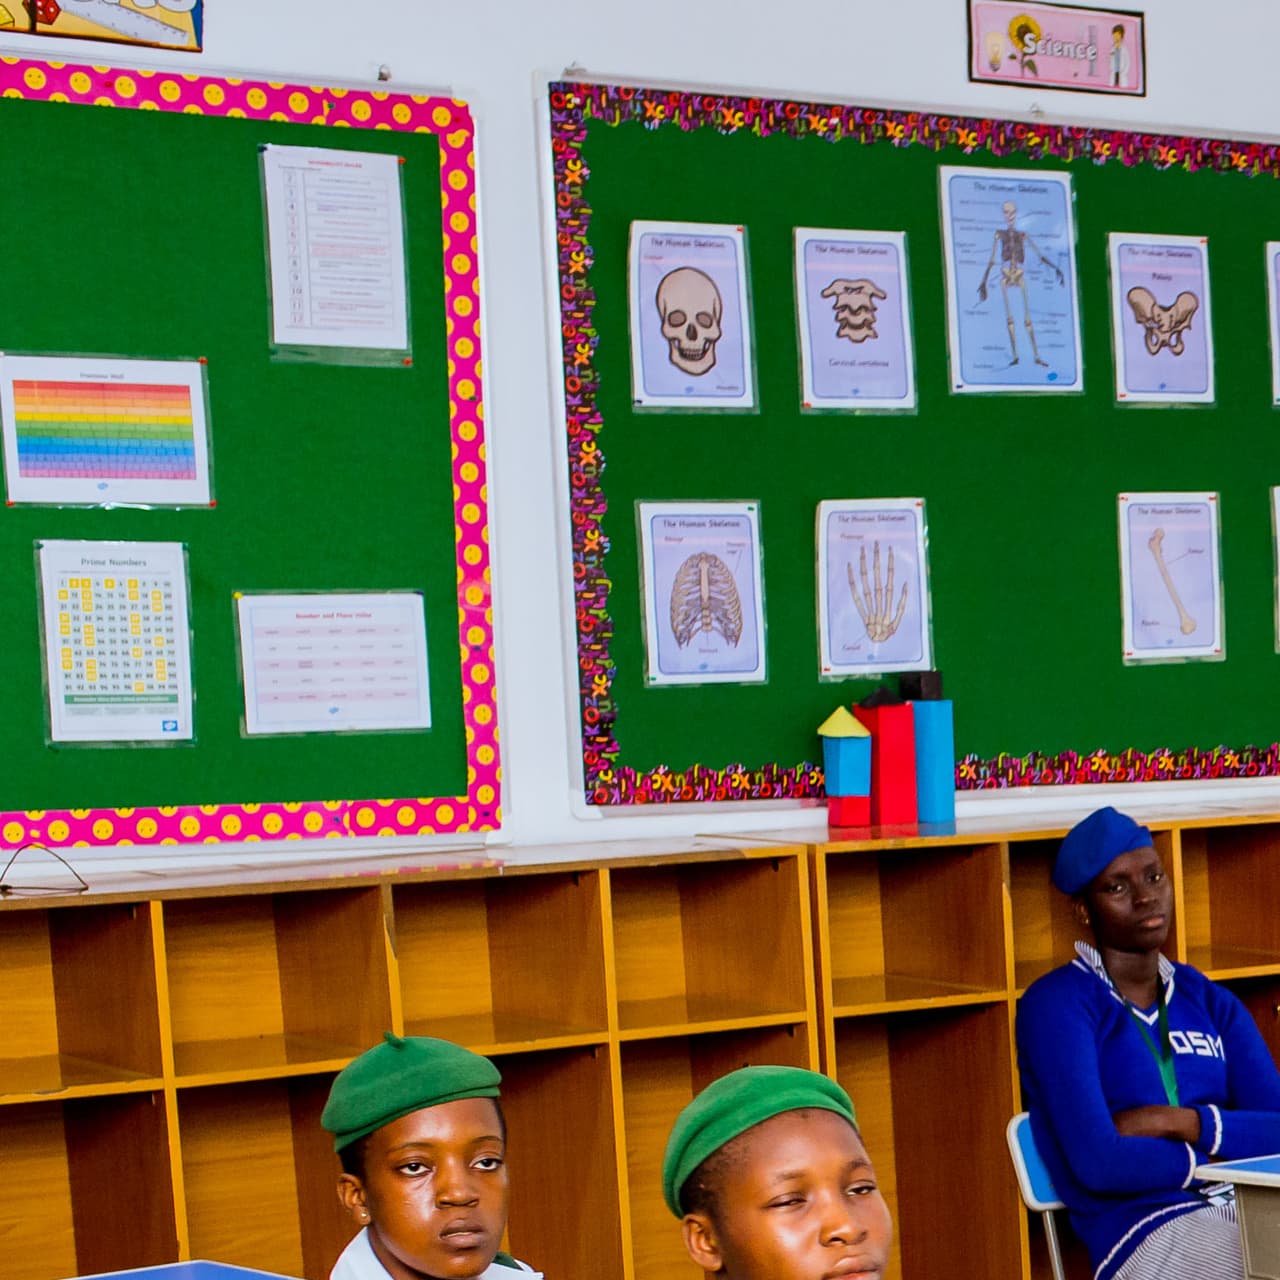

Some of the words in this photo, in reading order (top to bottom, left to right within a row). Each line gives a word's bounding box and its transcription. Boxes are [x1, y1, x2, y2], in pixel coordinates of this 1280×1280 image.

[1023, 33, 1097, 61] Science
[663, 520, 676, 528] The
[679, 520, 707, 528] Human
[709, 520, 741, 528] Skeleton
[81, 558, 106, 566] Prime
[109, 559, 147, 567] Numbers
